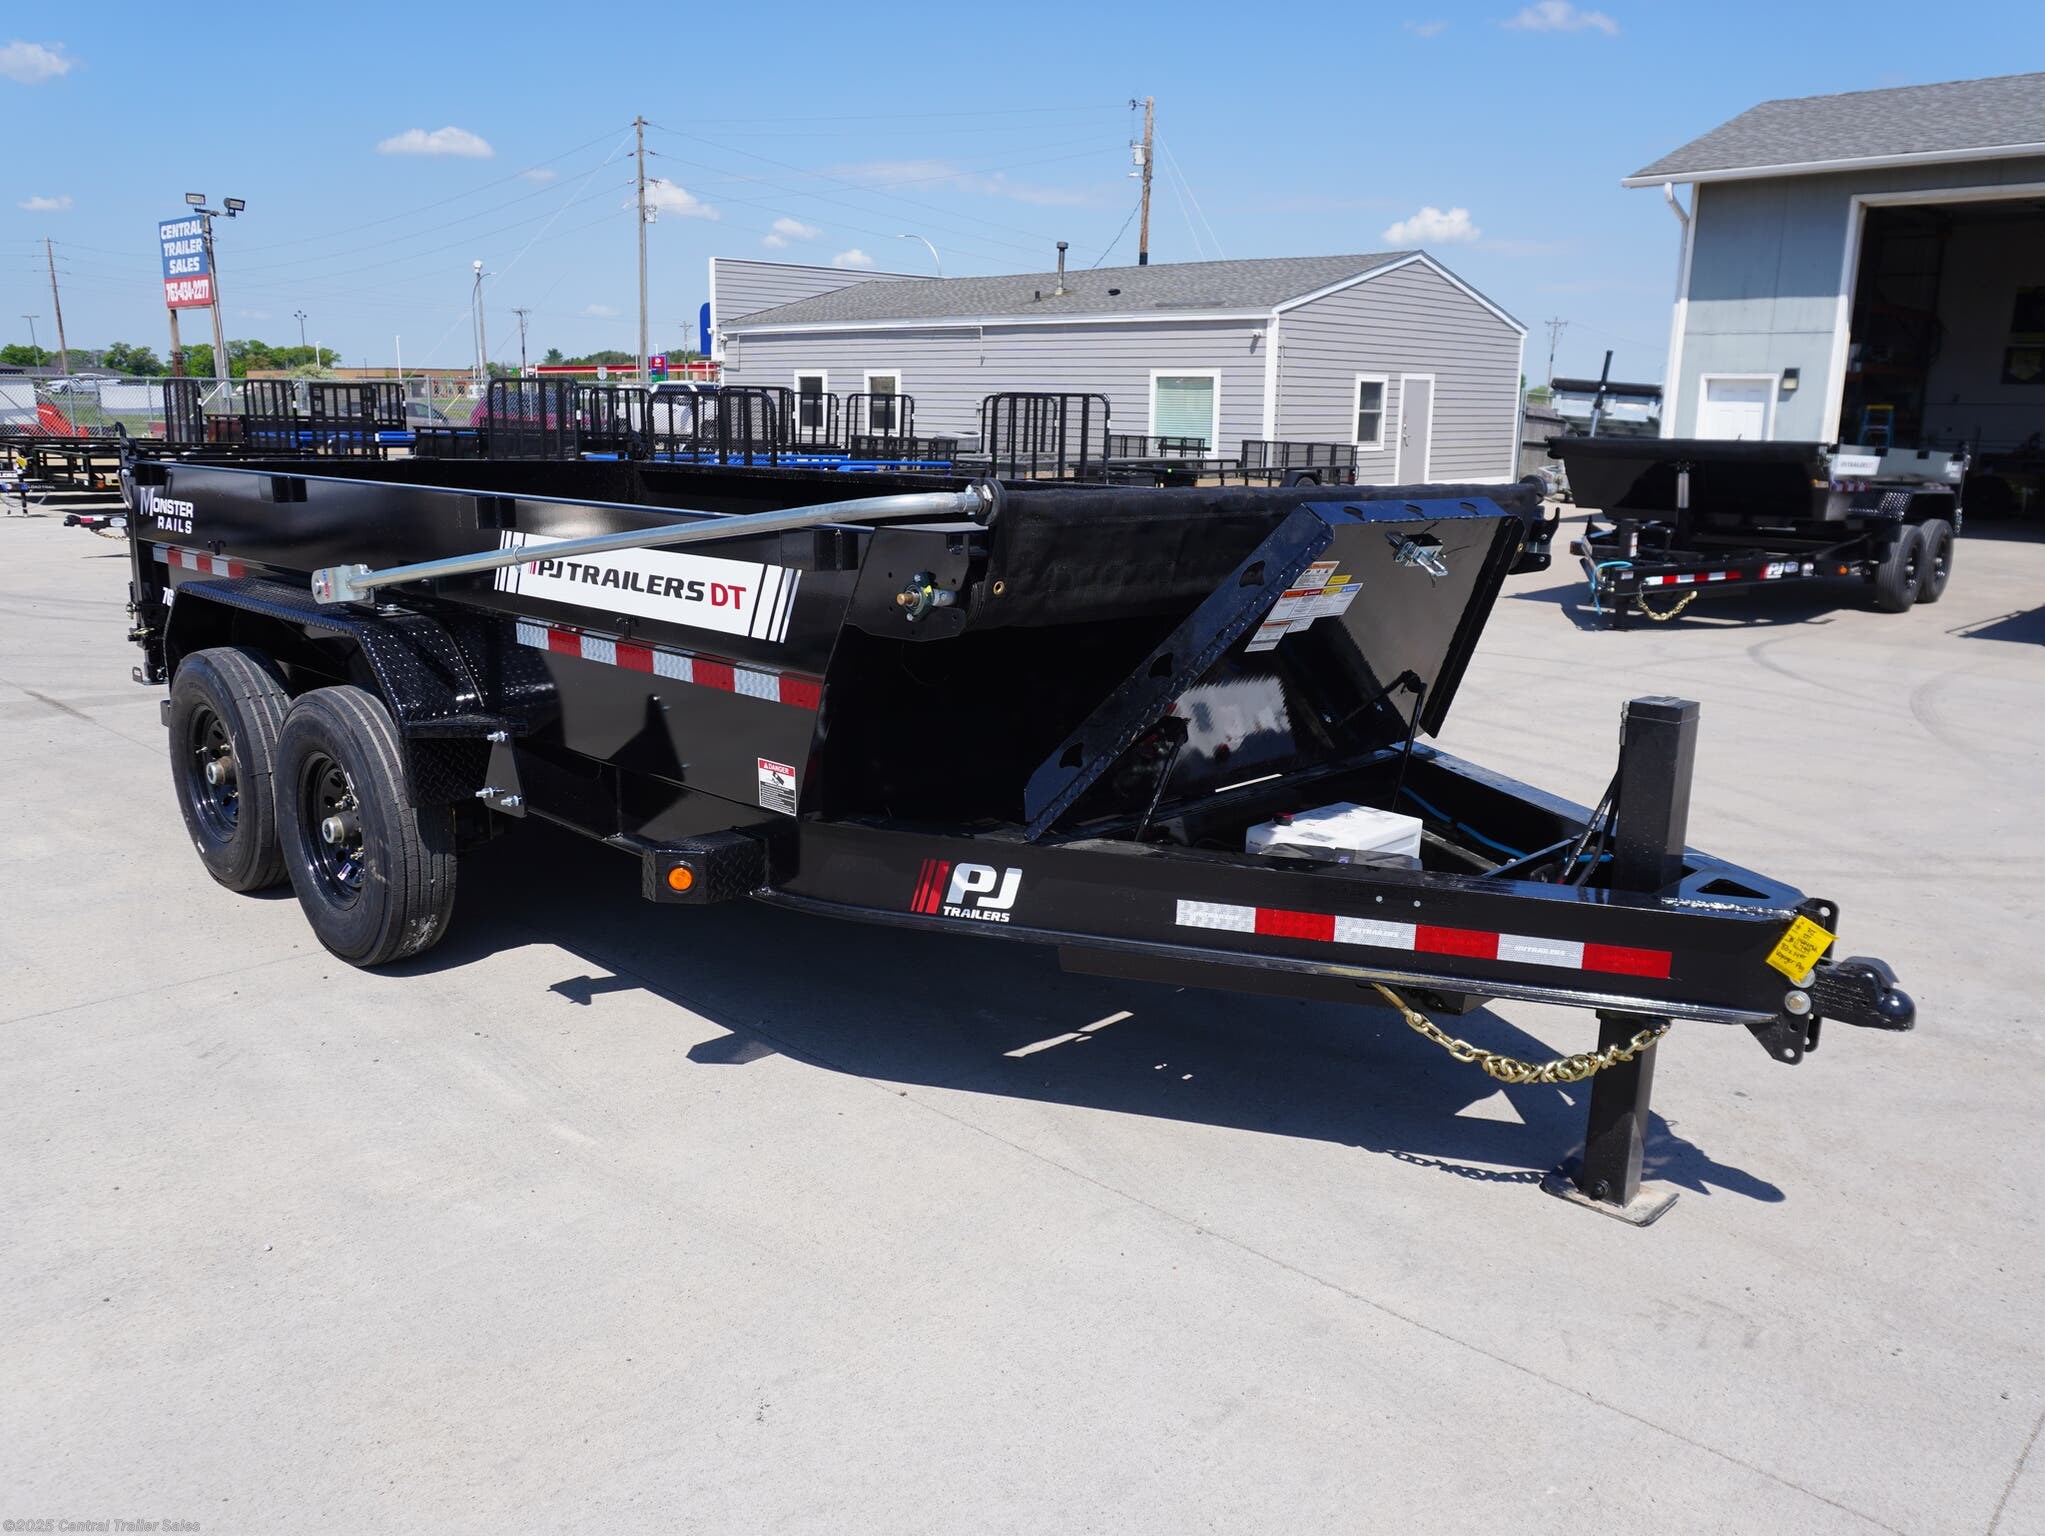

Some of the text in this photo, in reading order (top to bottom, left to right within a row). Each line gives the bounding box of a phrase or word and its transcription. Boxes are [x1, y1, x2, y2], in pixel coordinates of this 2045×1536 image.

[161, 219, 202, 240] CENTRAL
[163, 238, 203, 257] TRAILER
[169, 256, 200, 275] SALES
[140, 487, 194, 519] MONSTER
[158, 515, 192, 535] RAILS
[710, 582, 747, 610] DT
[946, 863, 1023, 910] PJ
[943, 906, 1011, 923] TRAILERS
